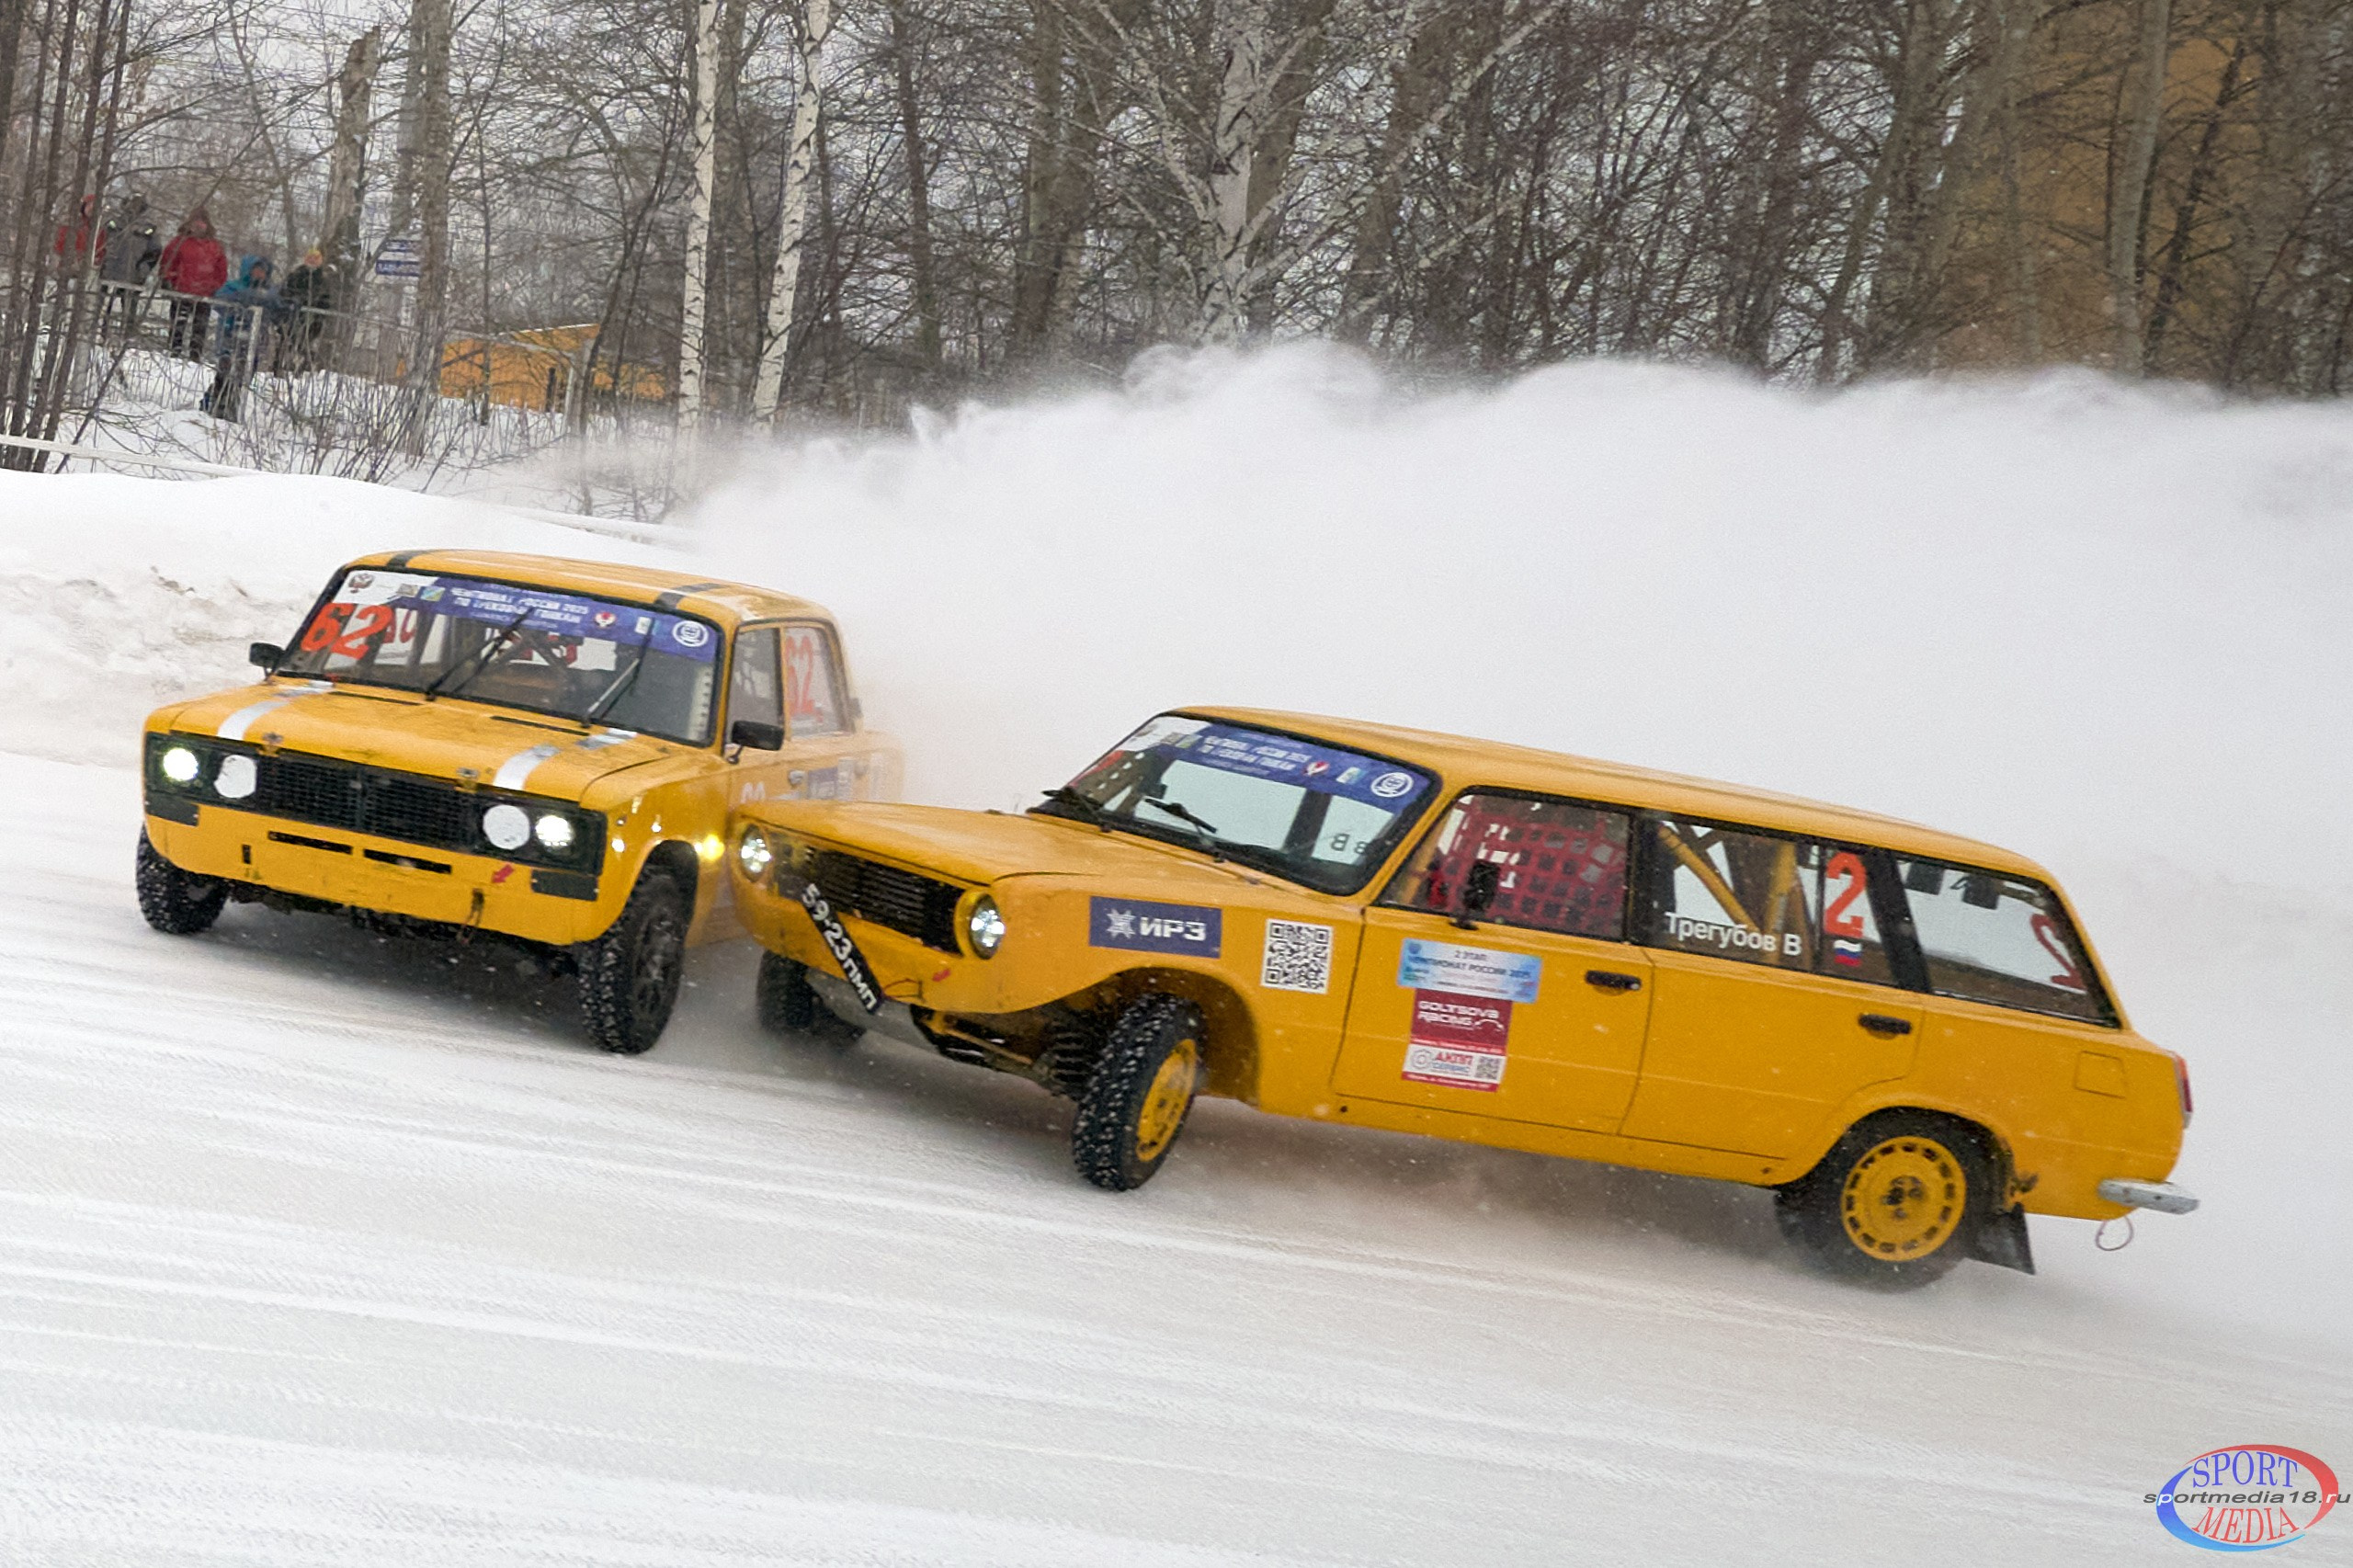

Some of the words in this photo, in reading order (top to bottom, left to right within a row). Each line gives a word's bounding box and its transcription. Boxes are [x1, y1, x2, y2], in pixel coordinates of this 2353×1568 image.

[301, 603, 393, 660] 62
[1824, 851, 1868, 938] 2
[1140, 916, 1207, 942] ИРЗ
[1665, 912, 1777, 952] Трегубов
[1782, 933, 1802, 957] В
